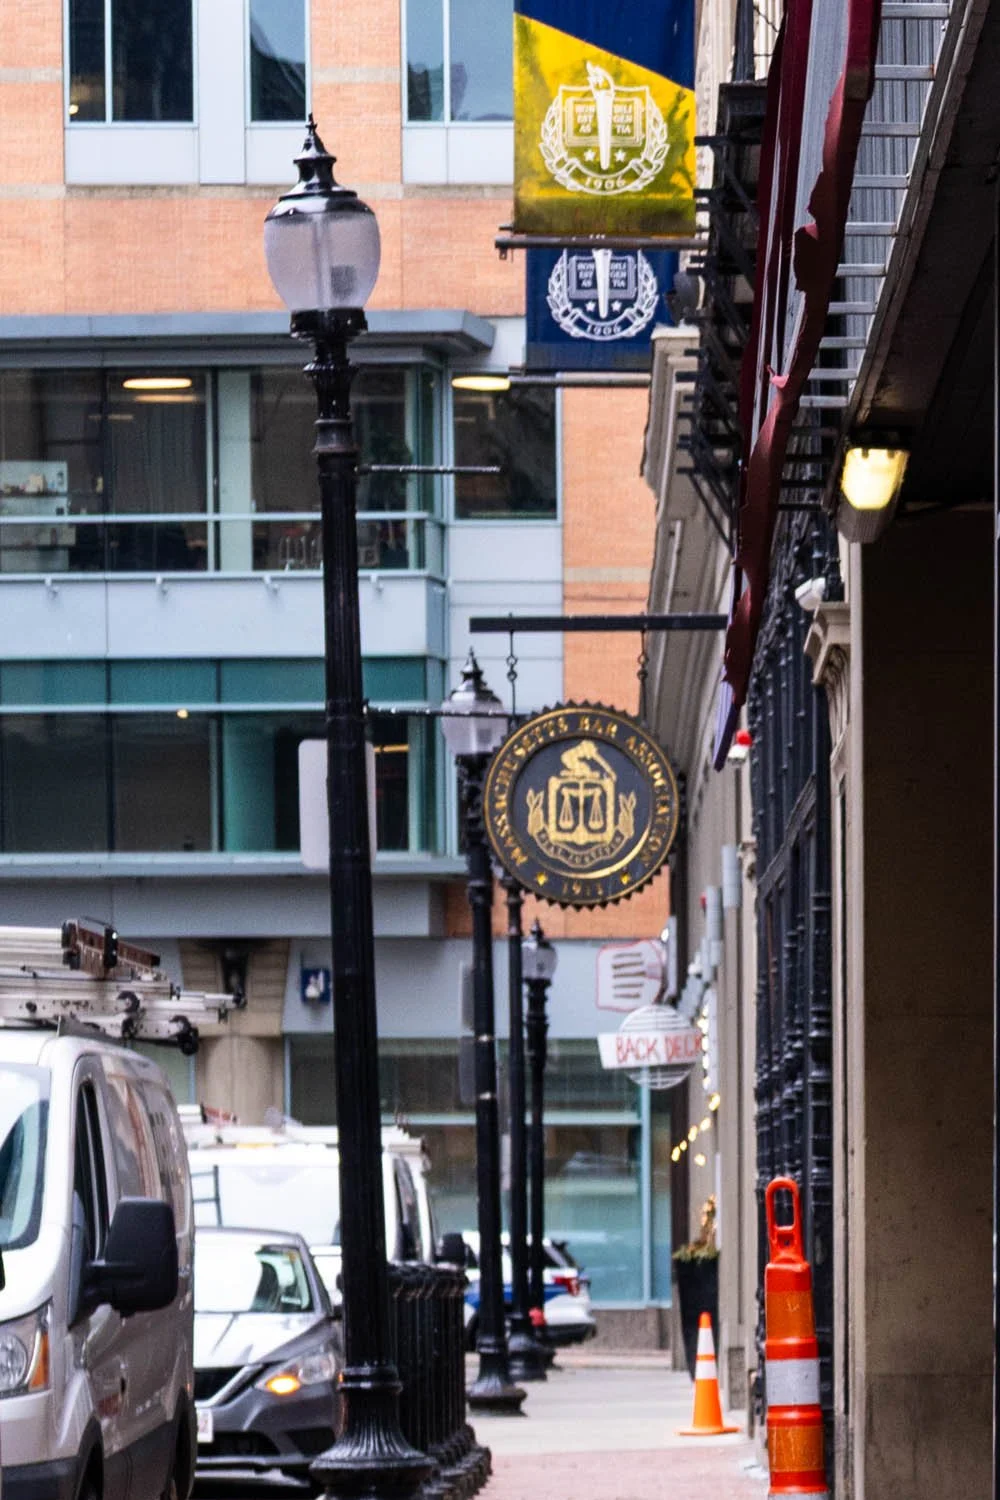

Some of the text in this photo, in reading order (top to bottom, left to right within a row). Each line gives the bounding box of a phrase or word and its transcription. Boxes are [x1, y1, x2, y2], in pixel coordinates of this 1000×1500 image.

[615, 125, 631, 134] TIA
[584, 175, 626, 189] 1906
[586, 322, 622, 336] 1906
[493, 715, 671, 867] MASSACHUSETTS BAR ASSOCIATION
[616, 1034, 660, 1064] BACK
